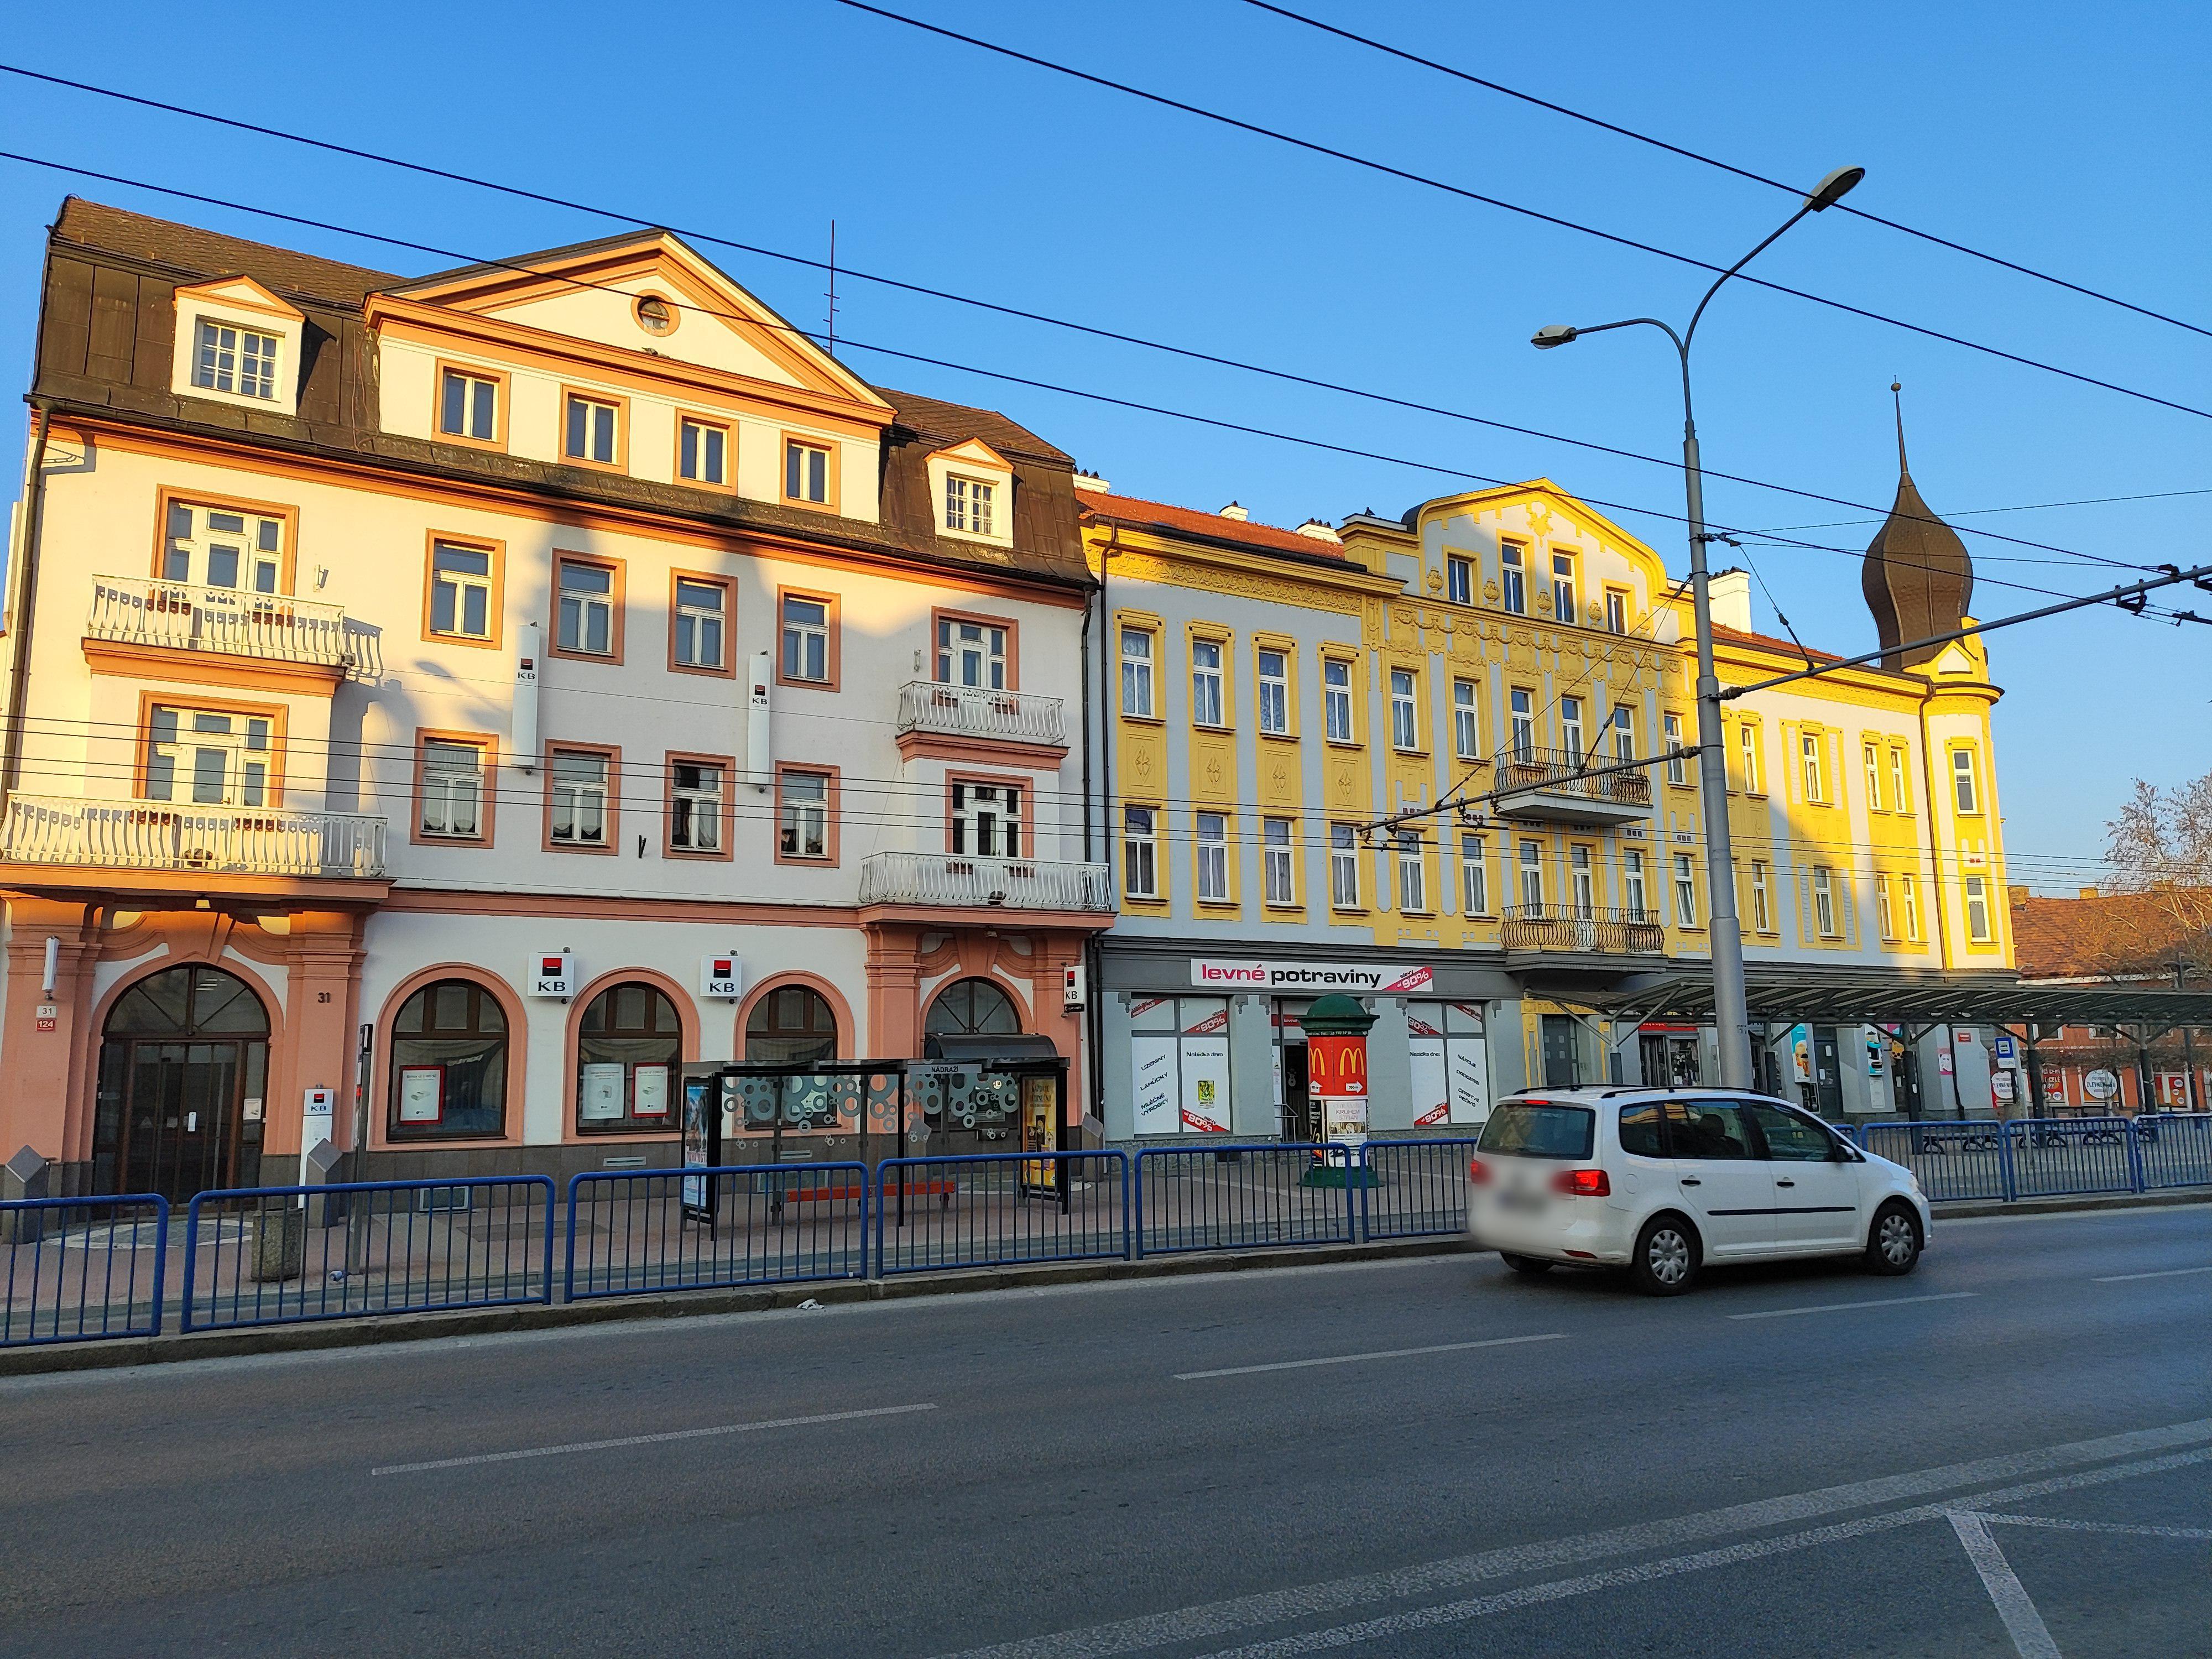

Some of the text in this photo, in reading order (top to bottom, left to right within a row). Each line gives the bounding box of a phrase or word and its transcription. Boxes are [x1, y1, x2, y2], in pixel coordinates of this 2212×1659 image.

[1202, 963, 1381, 988] levné potraviny
[1400, 970, 1413, 979] slevy
[1402, 971, 1429, 989] 90%
[538, 981, 566, 992] KB
[709, 982, 734, 992] KB
[317, 992, 331, 1003] 31
[1066, 990, 1077, 1000] KB
[1200, 1016, 1225, 1032] 90%
[1141, 1054, 1166, 1071] UZENINY
[1141, 1092, 1165, 1109] MLÉČNÉ
[1141, 1098, 1168, 1115] VÝROBKY
[1188, 1113, 1212, 1131] 90%
[1425, 1108, 1446, 1123] 90%
